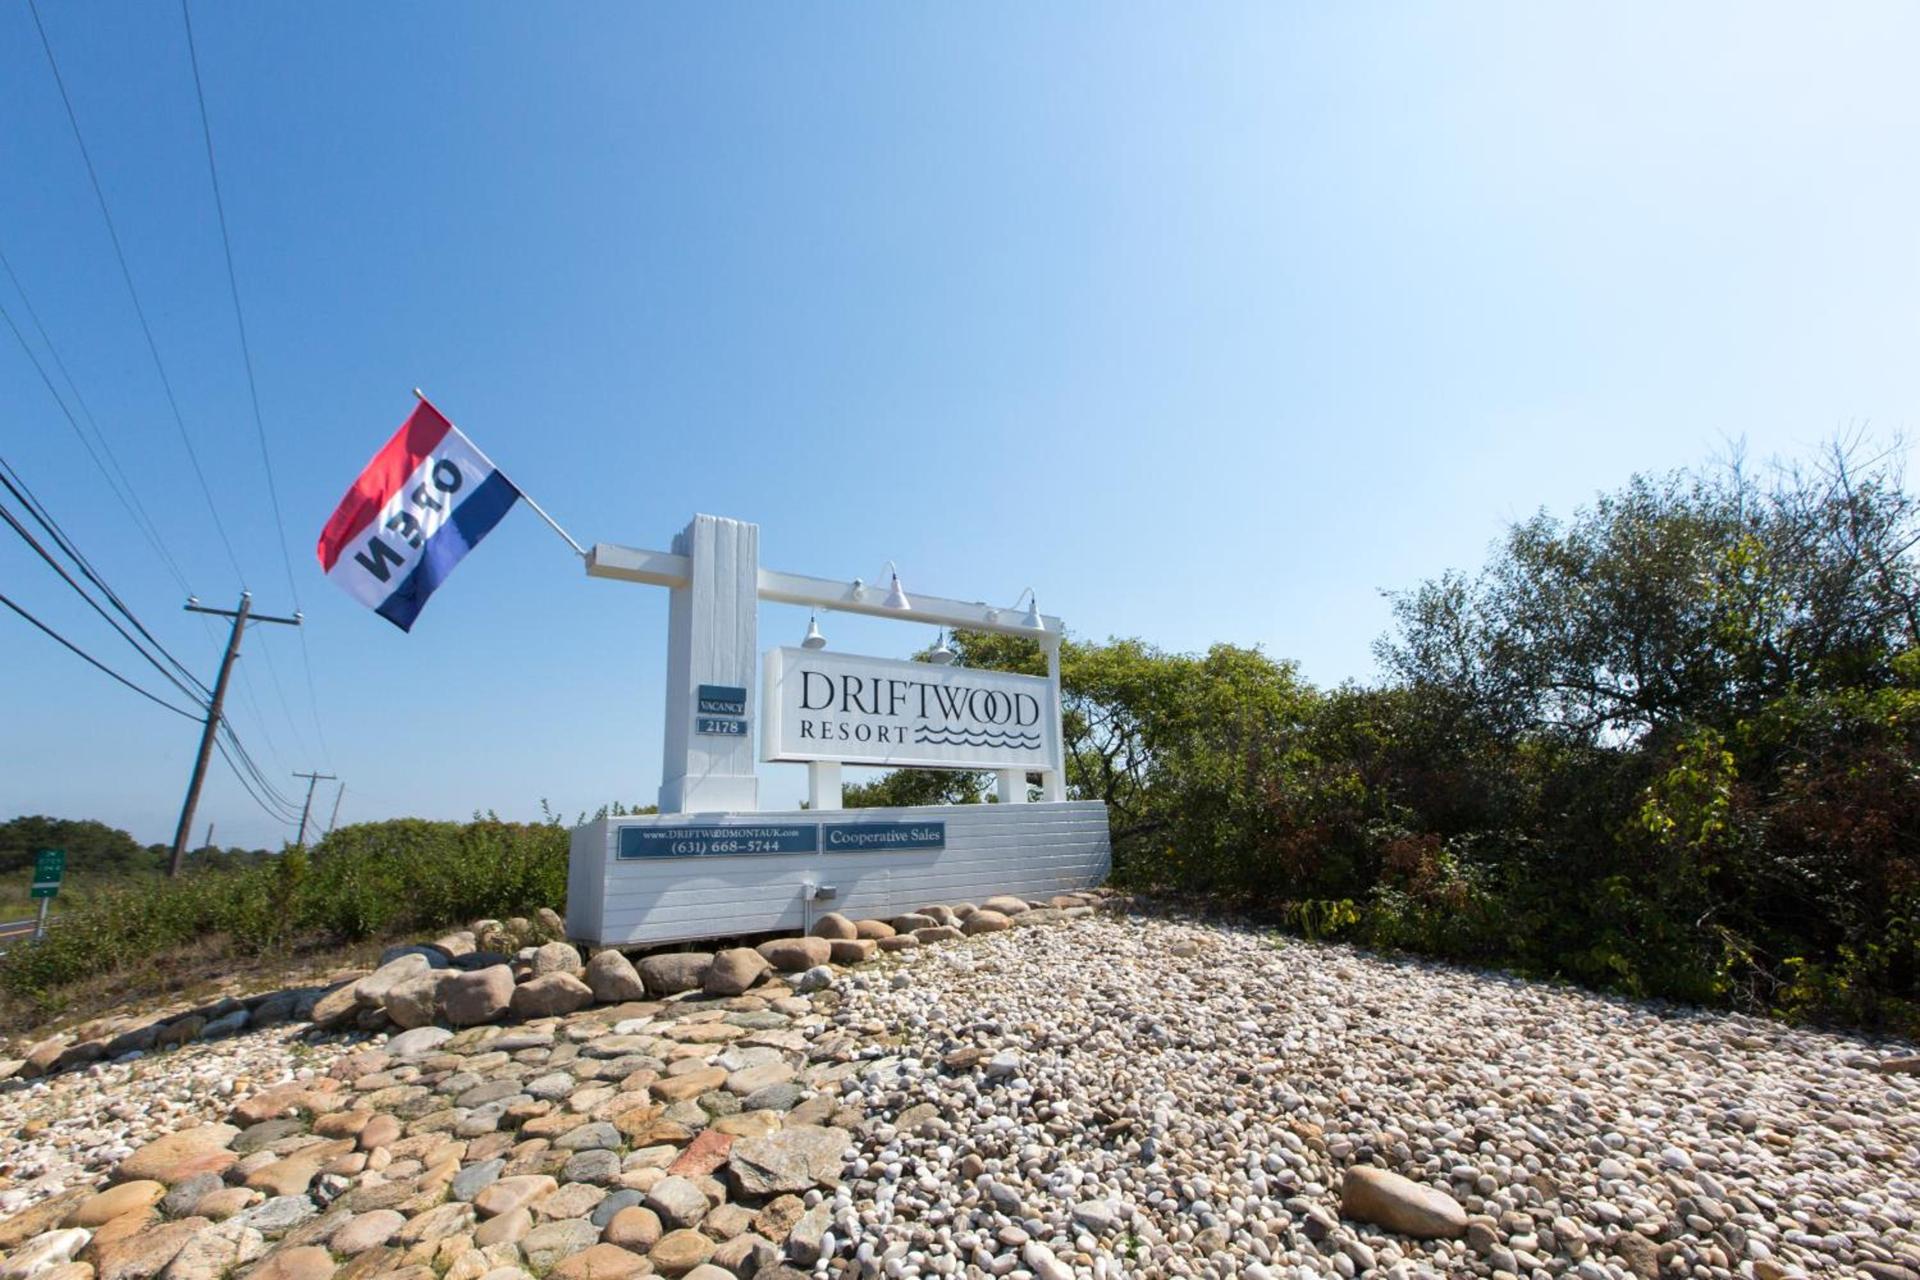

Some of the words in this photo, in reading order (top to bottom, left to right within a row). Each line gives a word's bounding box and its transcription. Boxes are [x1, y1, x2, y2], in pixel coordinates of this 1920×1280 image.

[701, 700, 744, 713] VACANCY
[798, 670, 1039, 727] DRIFTWOOD
[705, 721, 738, 733] 2178
[800, 719, 908, 744] RESORT
[830, 828, 908, 845] Cooperative
[910, 828, 940, 841] Sales
[671, 841, 706, 855] (631)
[711, 840, 780, 853] 668-5744
